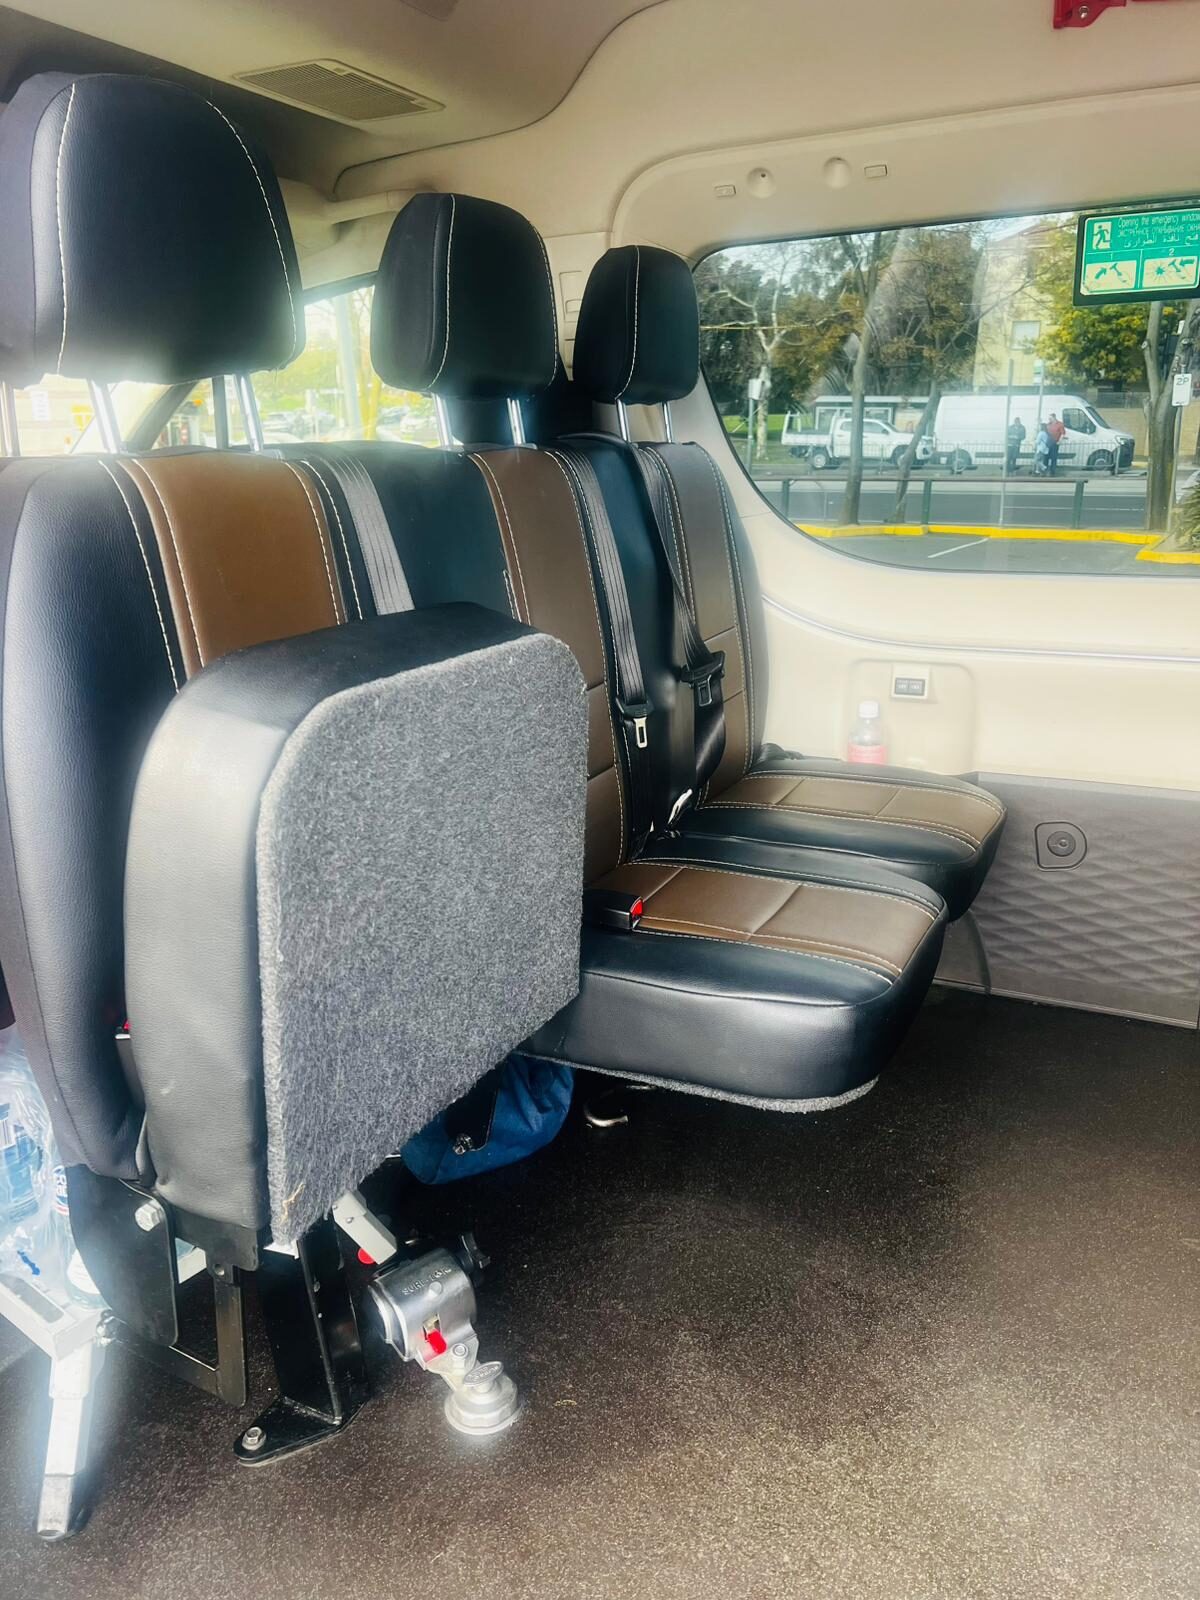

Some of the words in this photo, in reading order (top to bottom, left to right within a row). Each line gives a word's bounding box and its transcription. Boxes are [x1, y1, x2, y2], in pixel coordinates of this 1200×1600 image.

[1152, 215, 1179, 227] emergency
[1168, 248, 1175, 256] 2
[1176, 377, 1190, 386] 2P
